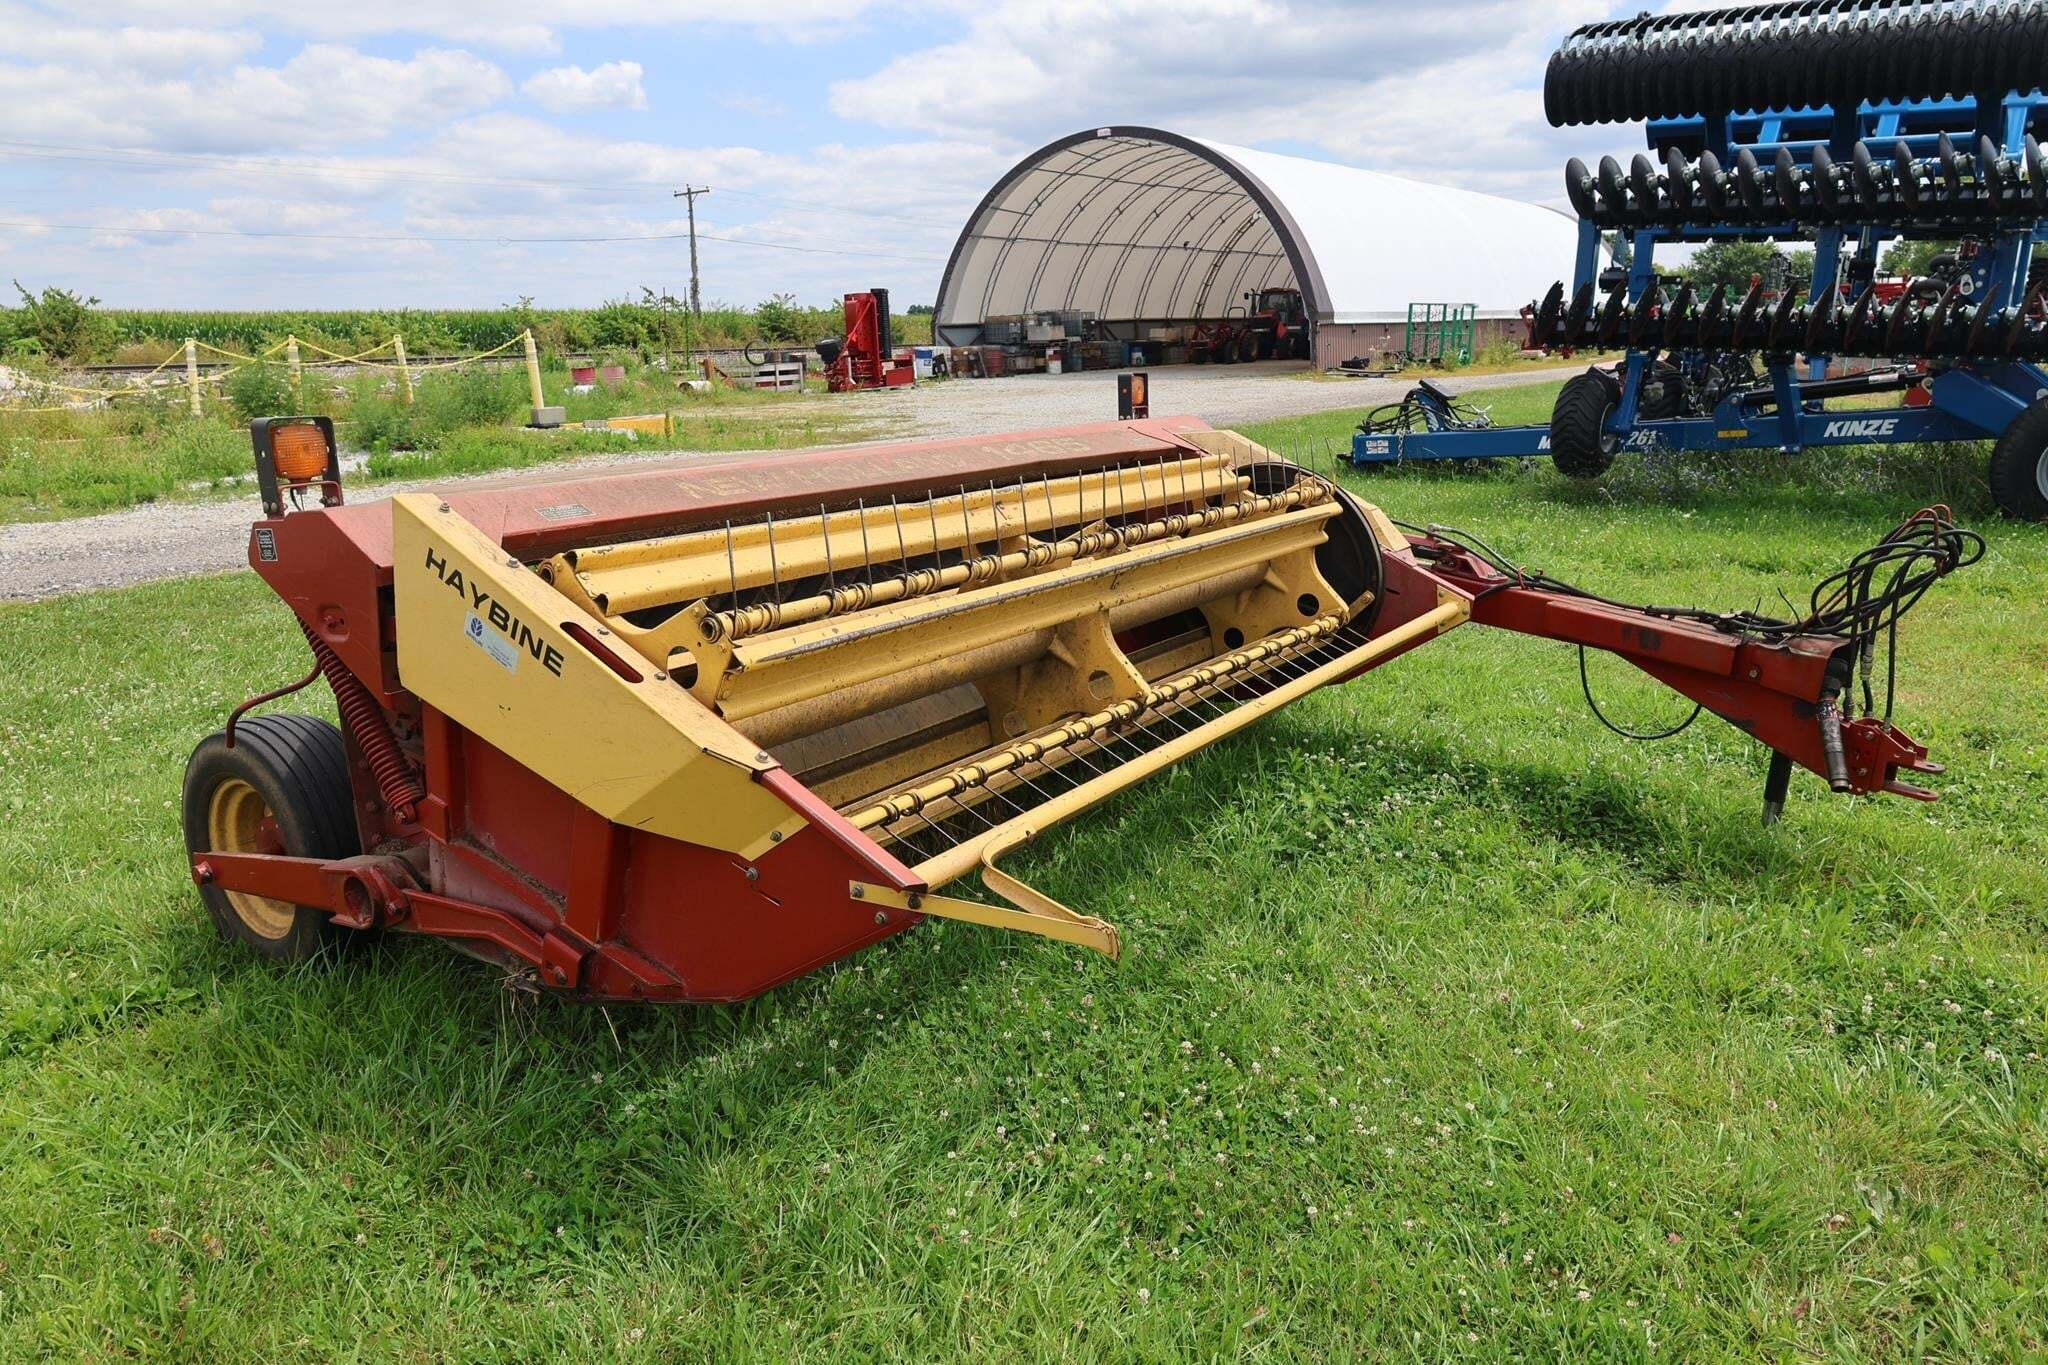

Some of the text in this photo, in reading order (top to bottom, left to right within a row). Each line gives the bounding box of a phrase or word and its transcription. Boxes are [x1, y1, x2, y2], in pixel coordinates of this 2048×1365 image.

[1823, 419, 1899, 438] KINZE
[674, 473, 789, 499] NEW
[425, 547, 565, 678] HAYBINE
